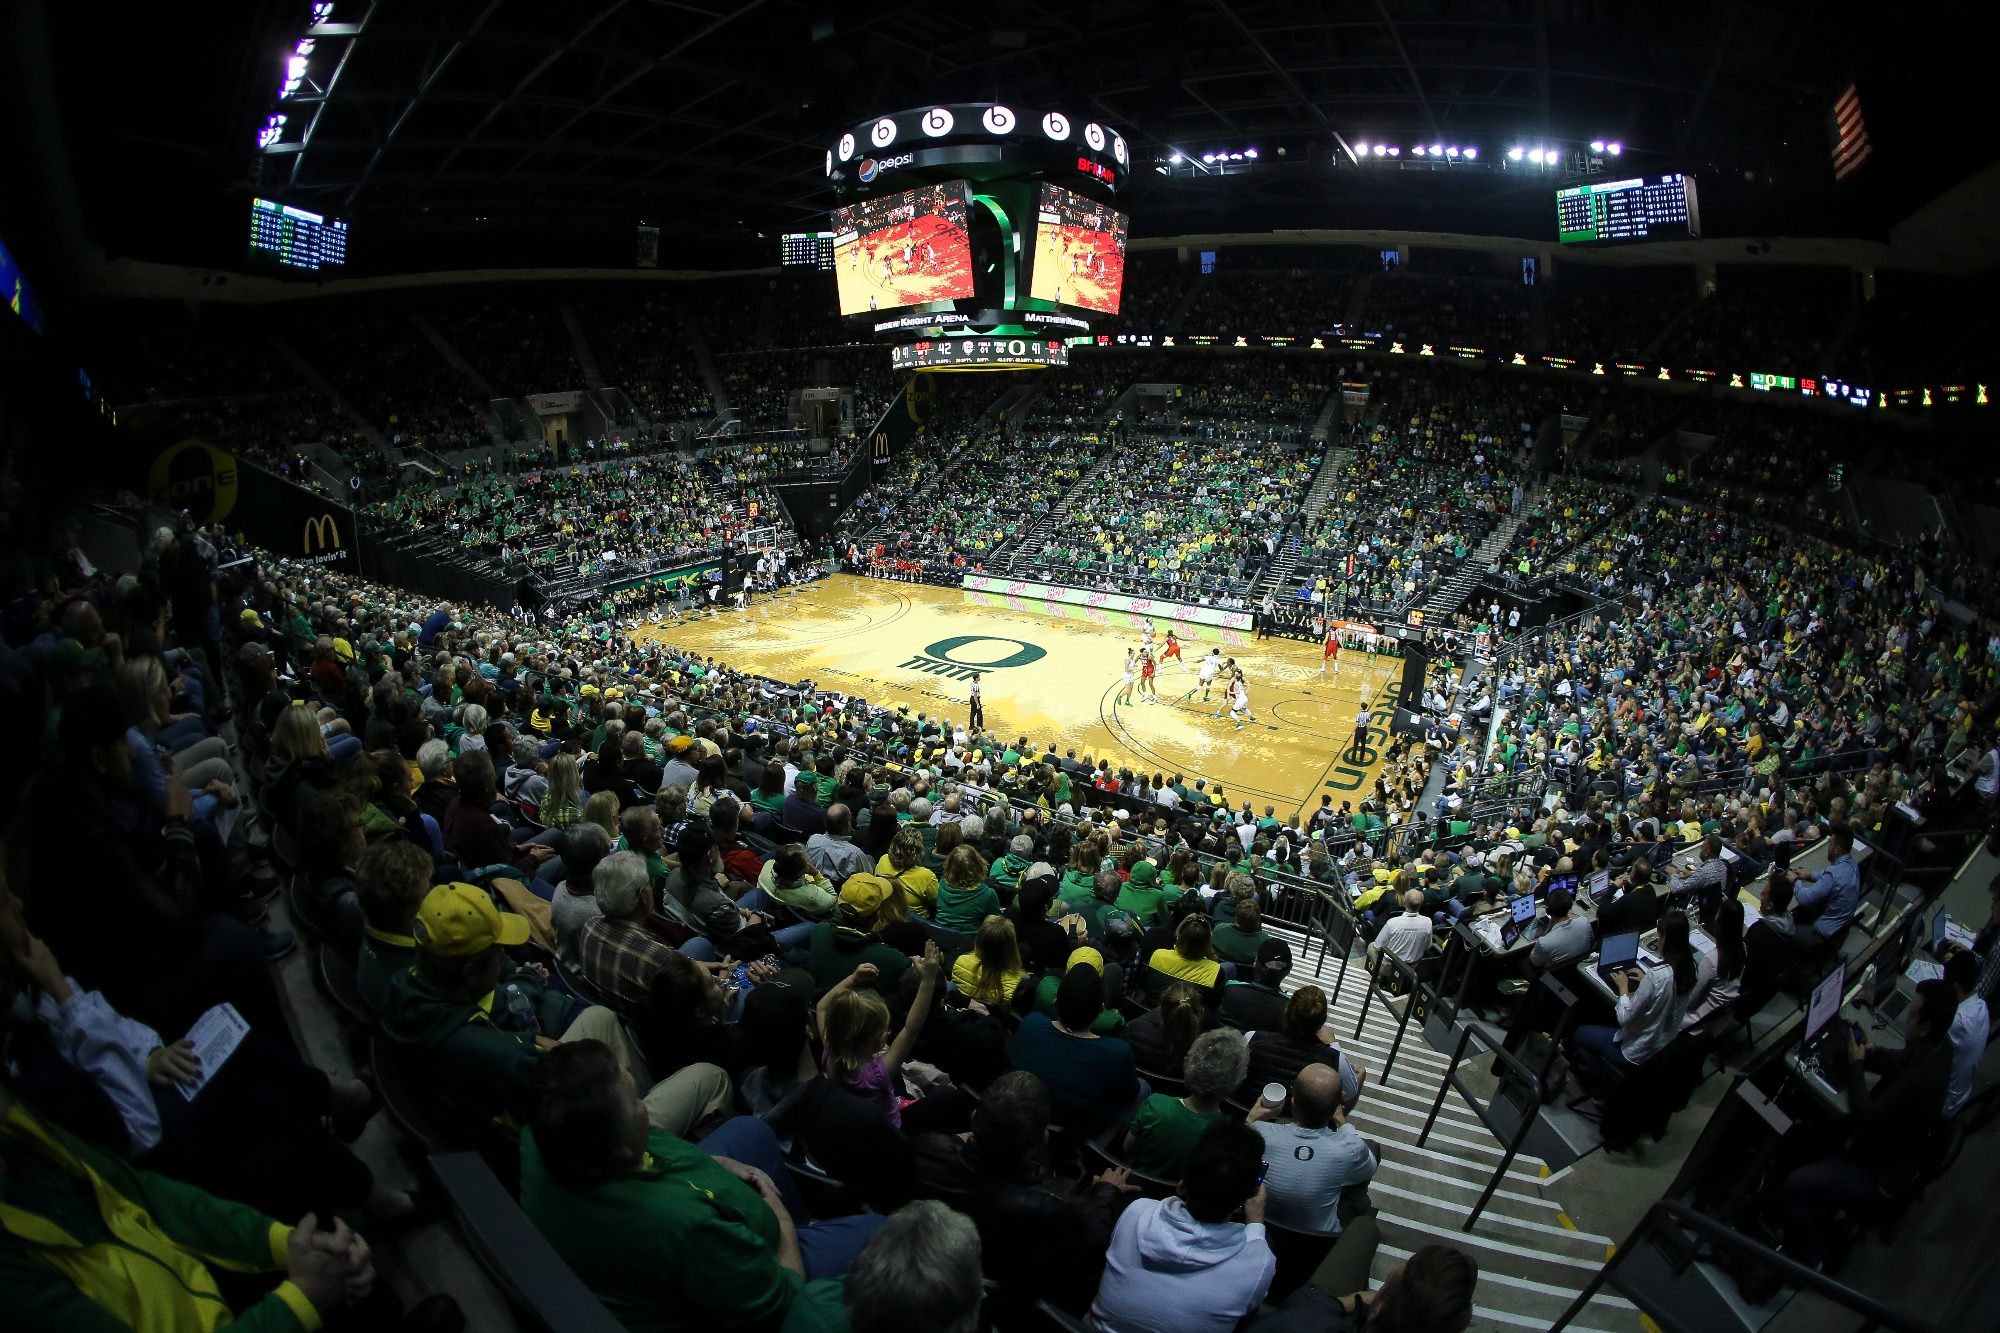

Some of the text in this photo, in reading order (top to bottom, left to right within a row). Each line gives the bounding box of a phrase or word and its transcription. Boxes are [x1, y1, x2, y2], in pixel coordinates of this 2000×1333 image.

[879, 152, 912, 173] pepsi
[901, 316, 933, 327] KNIGHT
[935, 314, 969, 324] ARENA
[938, 342, 952, 355] 42
[1032, 342, 1042, 355] 41
[1801, 378, 1816, 390] 8:56
[1825, 382, 1838, 397] 42
[315, 550, 339, 564] lovin'
[339, 549, 348, 559] it
[1294, 1144, 1314, 1162] O
